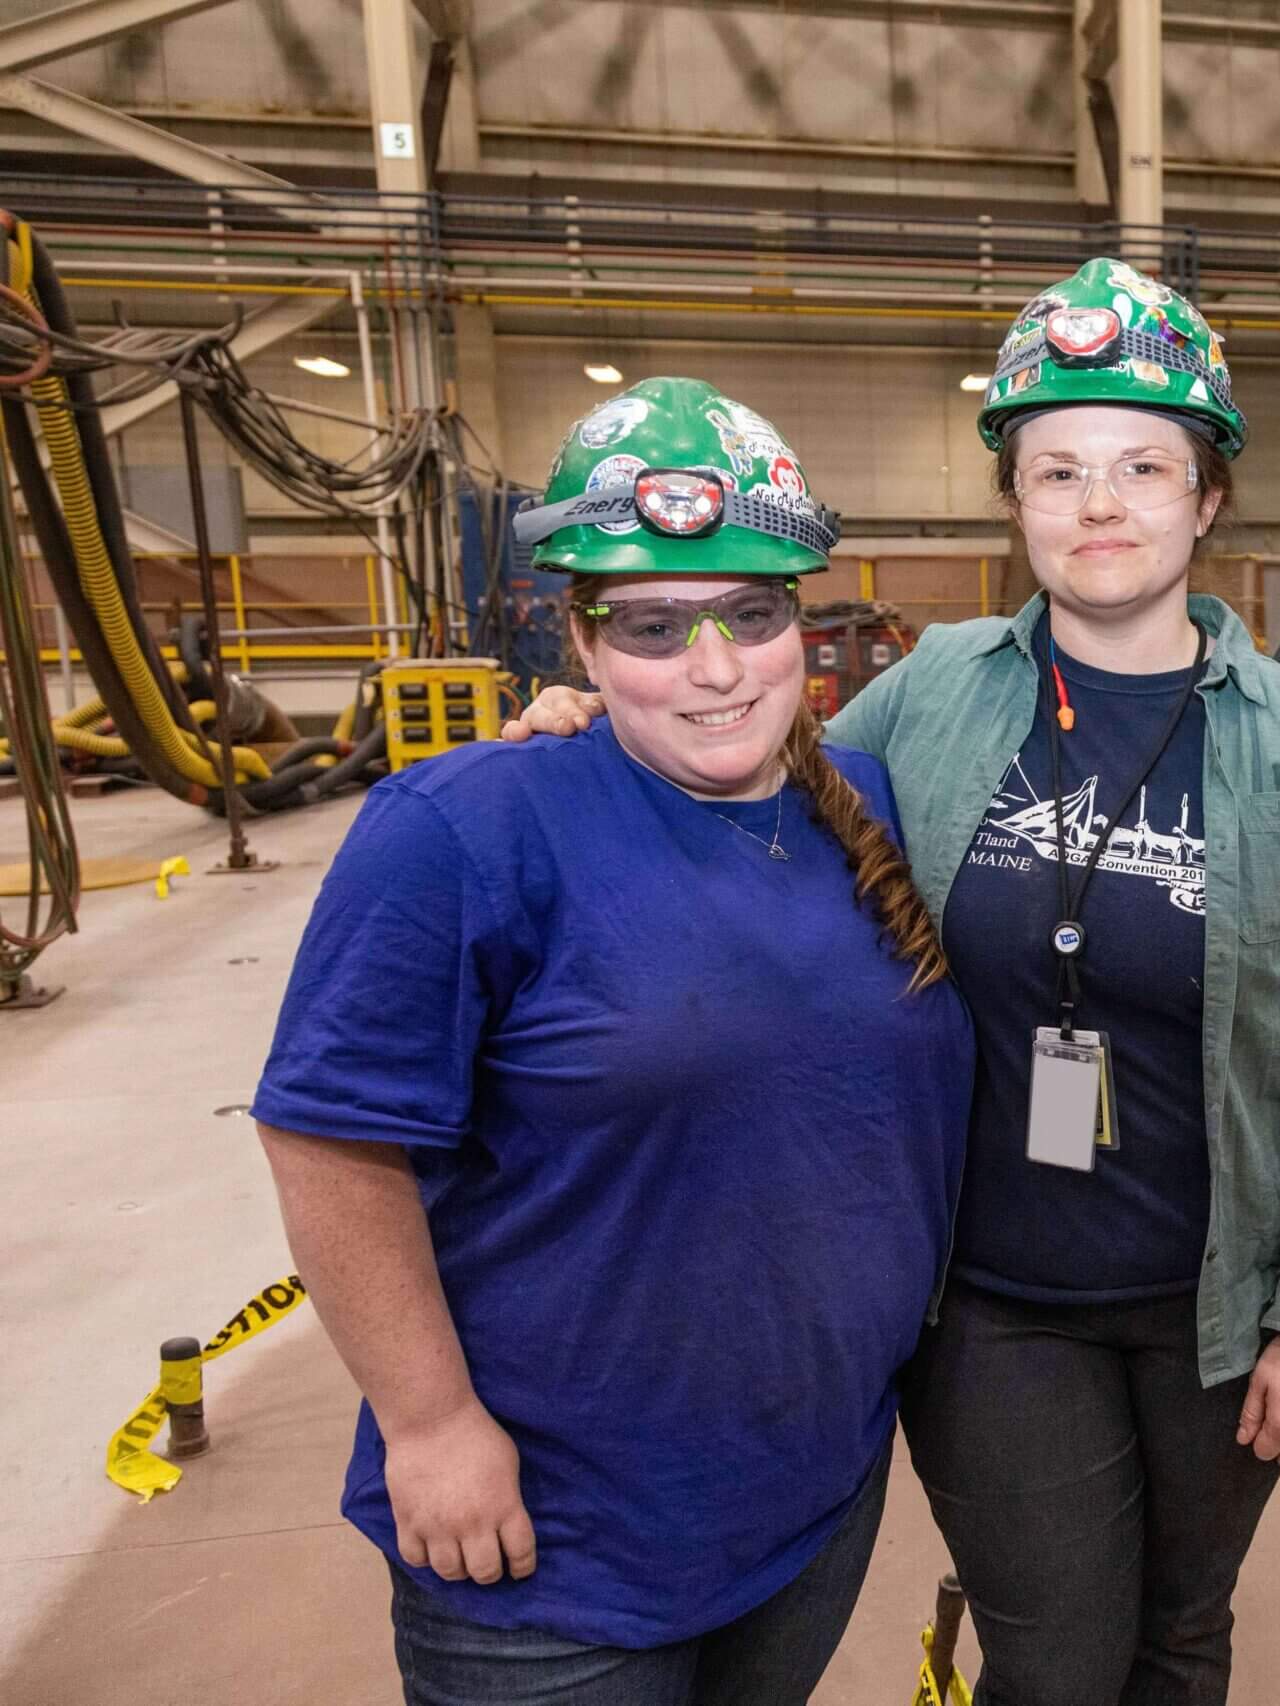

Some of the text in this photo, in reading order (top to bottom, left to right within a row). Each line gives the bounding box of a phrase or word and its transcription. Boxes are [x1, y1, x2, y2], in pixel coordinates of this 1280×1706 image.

[394, 132, 406, 149] 5
[967, 850, 1033, 872] MAINE
[1095, 857, 1177, 878] Convention
